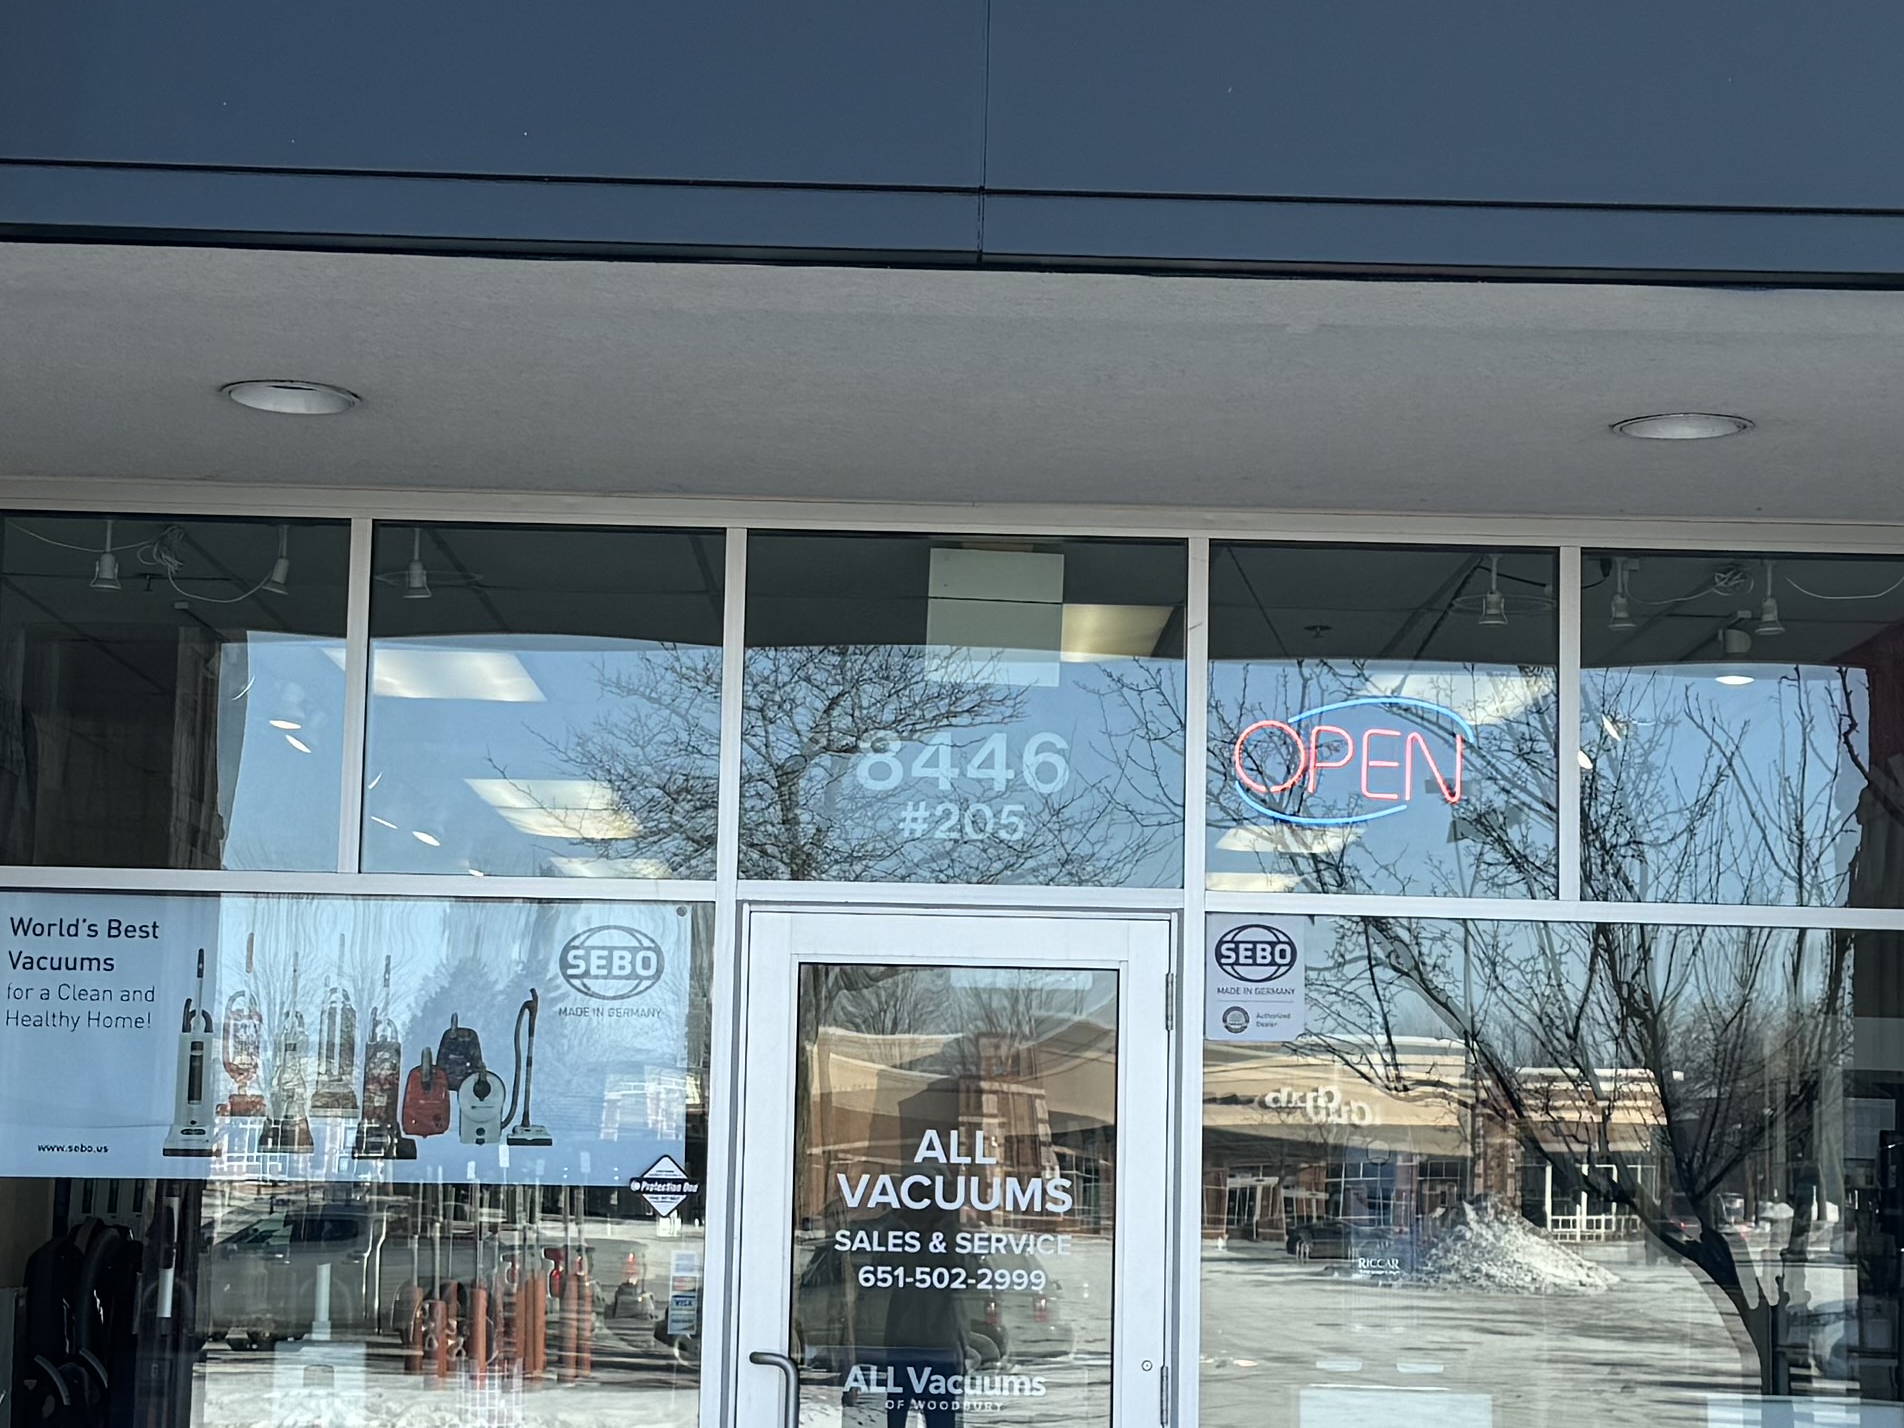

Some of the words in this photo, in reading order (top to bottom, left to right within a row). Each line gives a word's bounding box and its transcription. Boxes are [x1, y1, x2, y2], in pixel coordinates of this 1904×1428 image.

[855, 730, 1072, 794] 8446
[1233, 719, 1464, 806] OPEN
[899, 802, 1026, 840] #205
[9, 916, 100, 940] World's
[106, 918, 160, 942] Best
[8, 949, 116, 972] Vacuums
[566, 949, 658, 976] SEBO
[1220, 941, 1292, 964] SEBO
[7, 982, 32, 1002] for
[39, 987, 52, 1002] a
[58, 983, 114, 1002] Clean
[120, 983, 156, 1004] and
[1216, 986, 1242, 994] MADE
[1243, 987, 1254, 996] IN
[1254, 987, 1296, 996] GERMANY
[5, 1009, 82, 1034] Healthy
[88, 1010, 152, 1030] Home!
[558, 1007, 590, 1016] MADE
[593, 1007, 604, 1016] IN
[607, 1007, 662, 1018] GERMANY
[1256, 1012, 1290, 1020] Authorized
[913, 1129, 998, 1166] ALL
[837, 1174, 1074, 1214] VACUUMS
[834, 1230, 922, 1254] SALES
[929, 1232, 948, 1254] &
[955, 1233, 1072, 1256] SERVICE
[1358, 1257, 1400, 1270] RICCAR
[858, 1266, 1048, 1292] 651-502-2999
[842, 1364, 904, 1394] ALL
[907, 1366, 1048, 1396] Vacuums
[885, 1400, 906, 1410] OF
[910, 1399, 1004, 1412] WOODBURY
